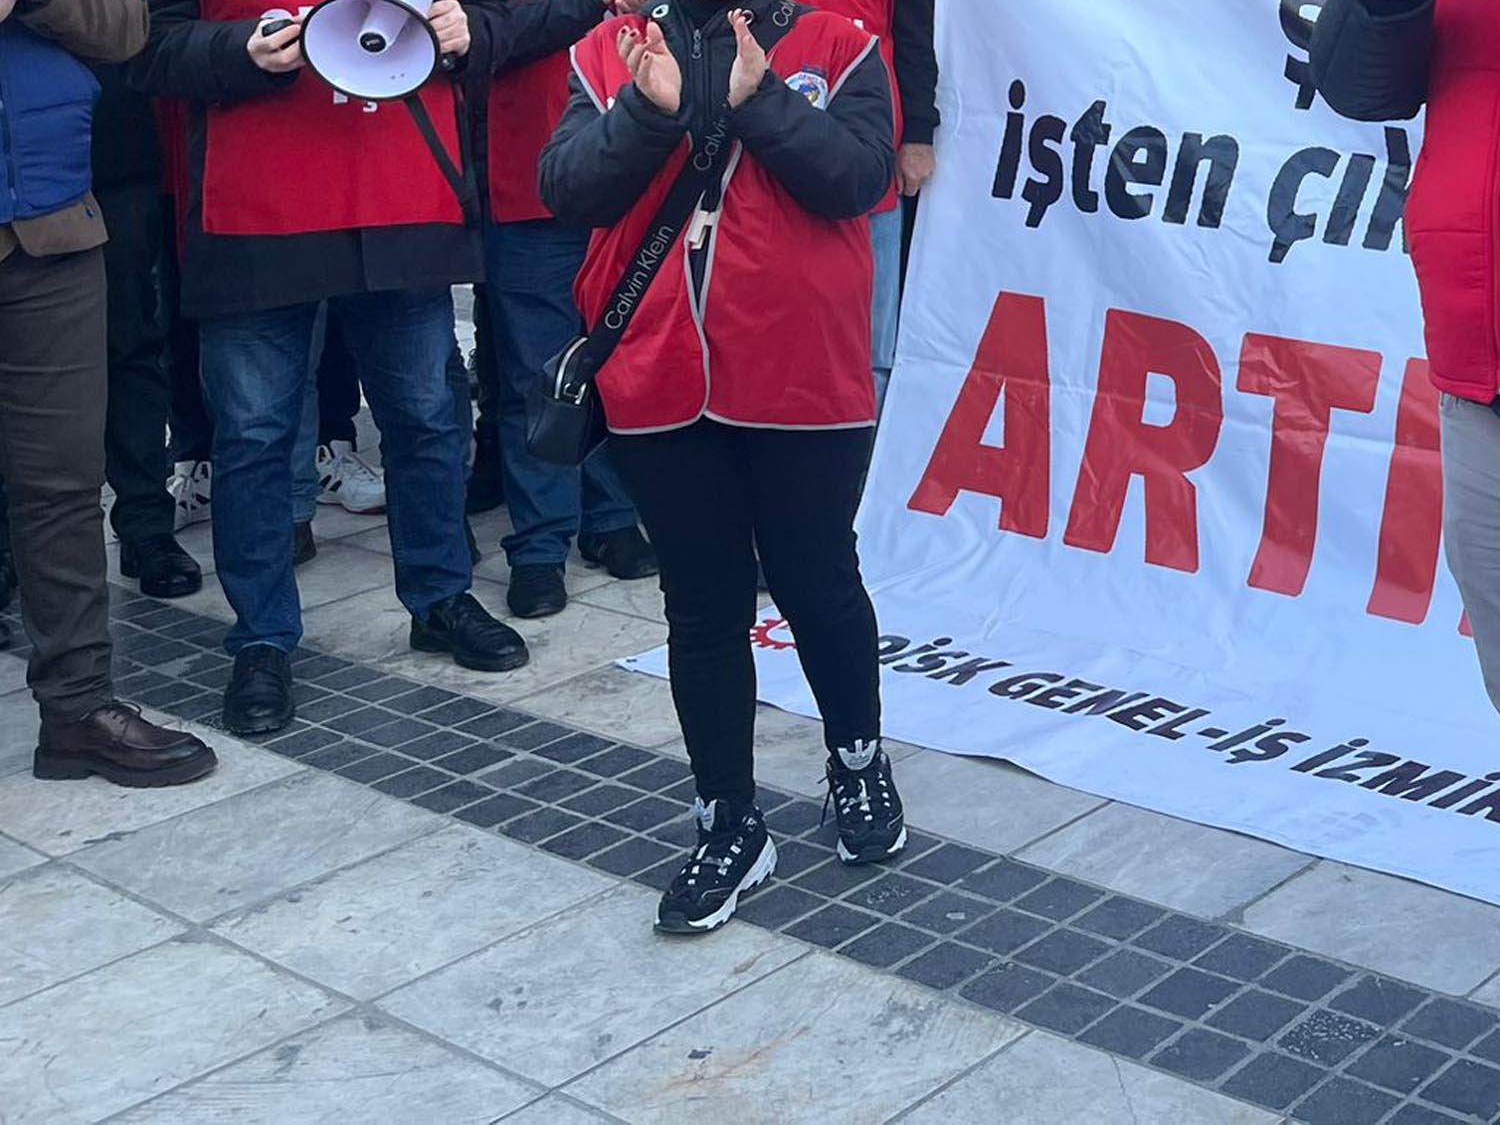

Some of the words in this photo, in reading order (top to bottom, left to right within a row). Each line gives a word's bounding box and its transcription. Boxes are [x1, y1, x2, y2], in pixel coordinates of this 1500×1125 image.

[992, 79, 1240, 228] işten
[604, 271, 649, 330] Calvin
[637, 225, 674, 271] Klein
[907, 290, 1479, 639] ARTI
[878, 635, 1014, 686] DİSK
[988, 672, 1312, 765] GENEL-İŞ
